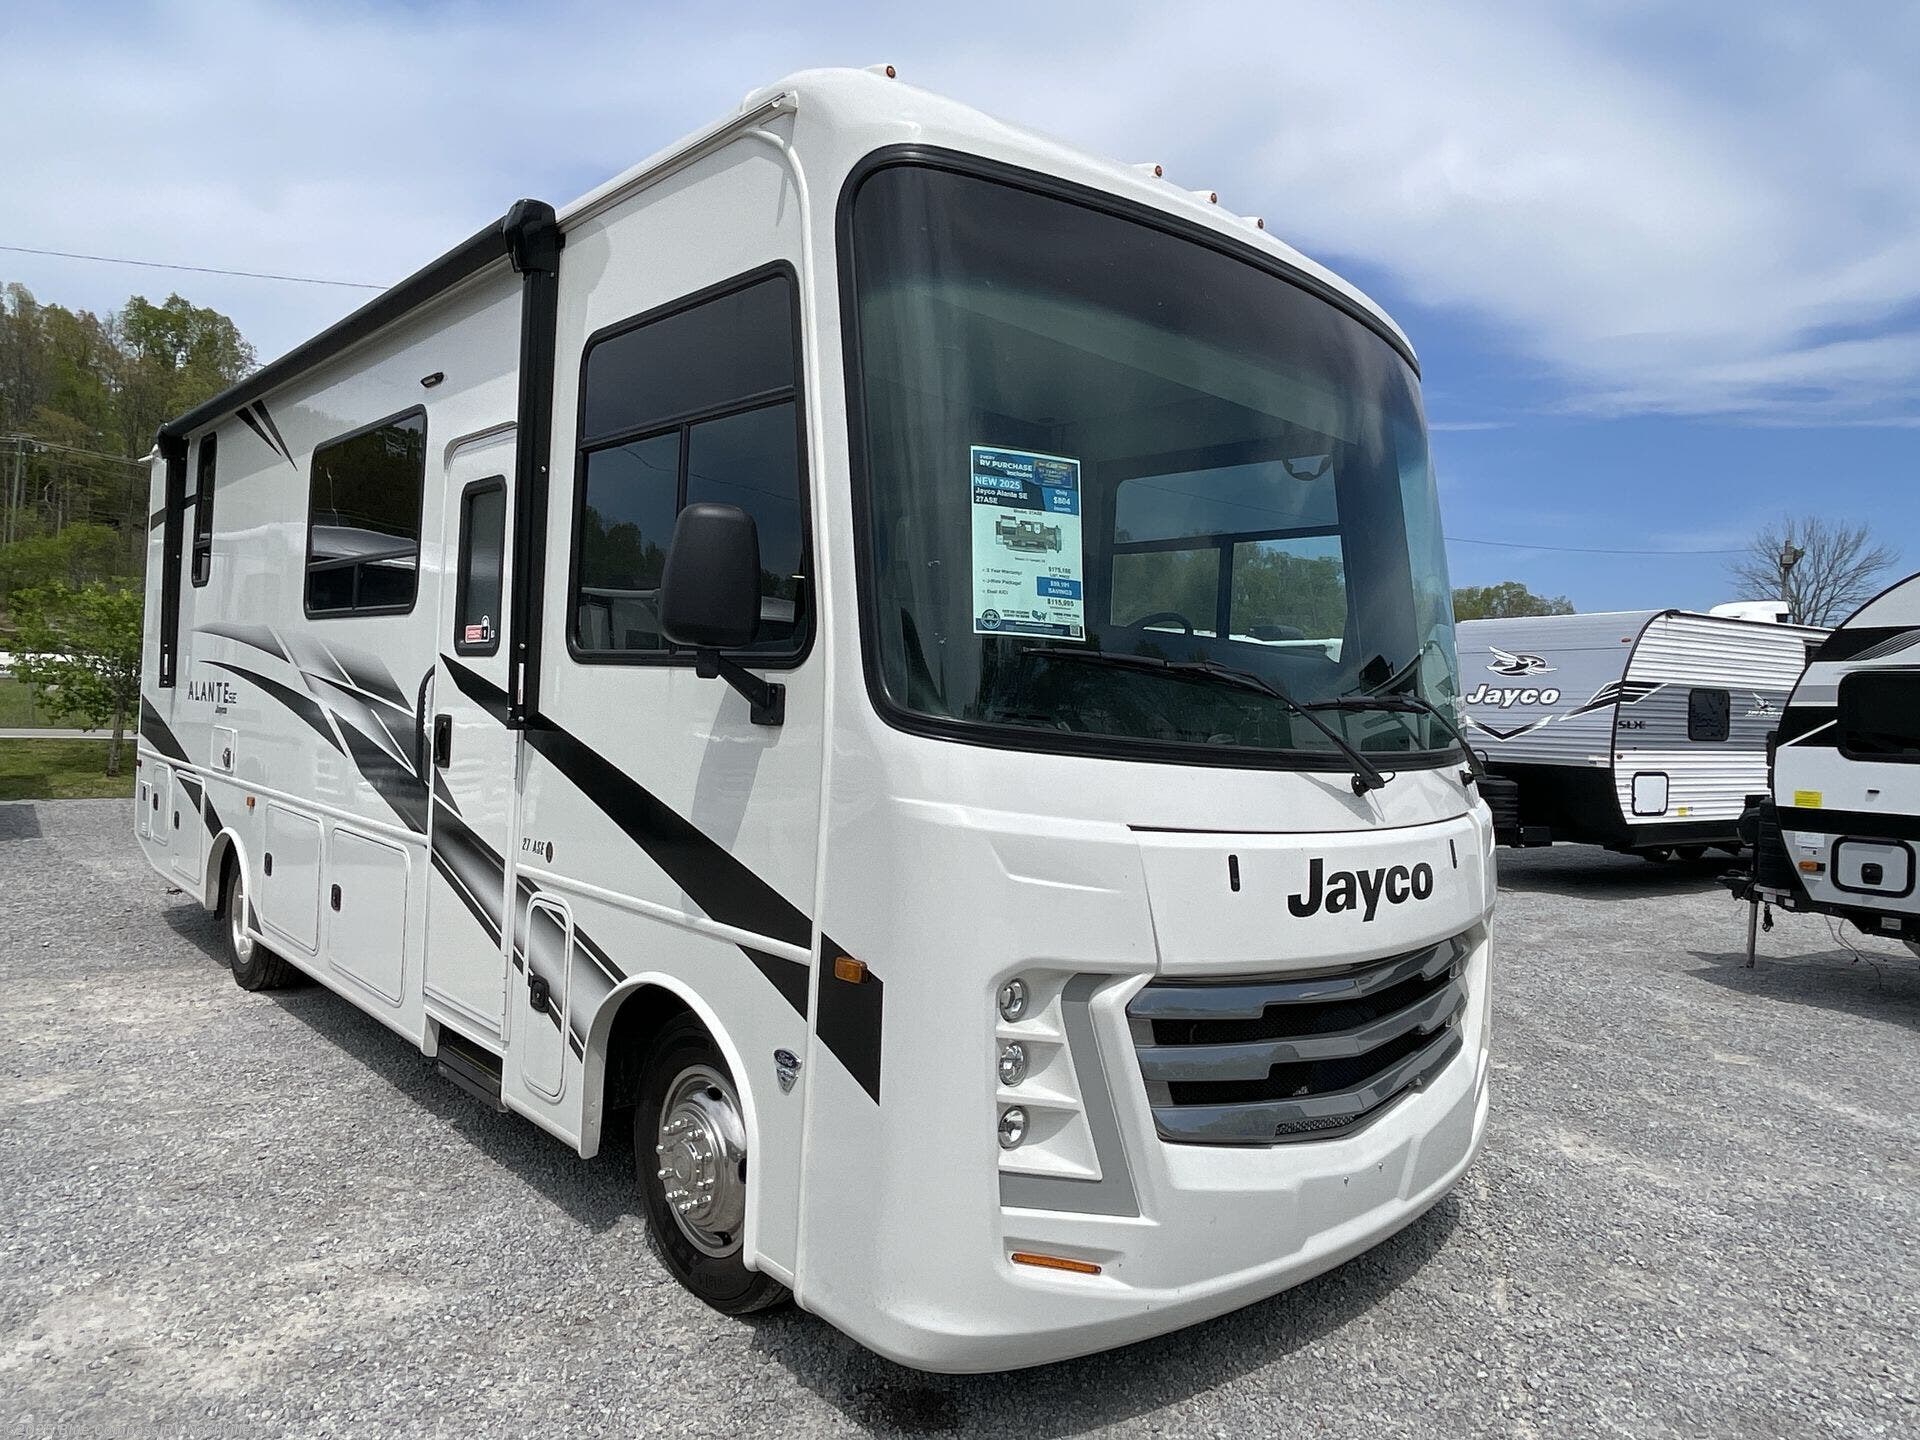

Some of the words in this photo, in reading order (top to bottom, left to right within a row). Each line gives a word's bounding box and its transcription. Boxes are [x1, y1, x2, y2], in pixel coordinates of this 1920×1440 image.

[992, 461, 1033, 471] PURCHASE
[974, 476, 998, 486] NEW
[1000, 479, 1020, 490] 2025
[975, 487, 996, 496] Jayco
[1018, 492, 1028, 500] SE
[975, 495, 998, 504] 27ASE
[1055, 489, 1068, 497] Only
[188, 681, 229, 704] ALANTE
[1466, 684, 1561, 709] Jayco
[522, 837, 531, 851] 27
[532, 840, 545, 856] ASE
[1287, 857, 1434, 923] Jayco
